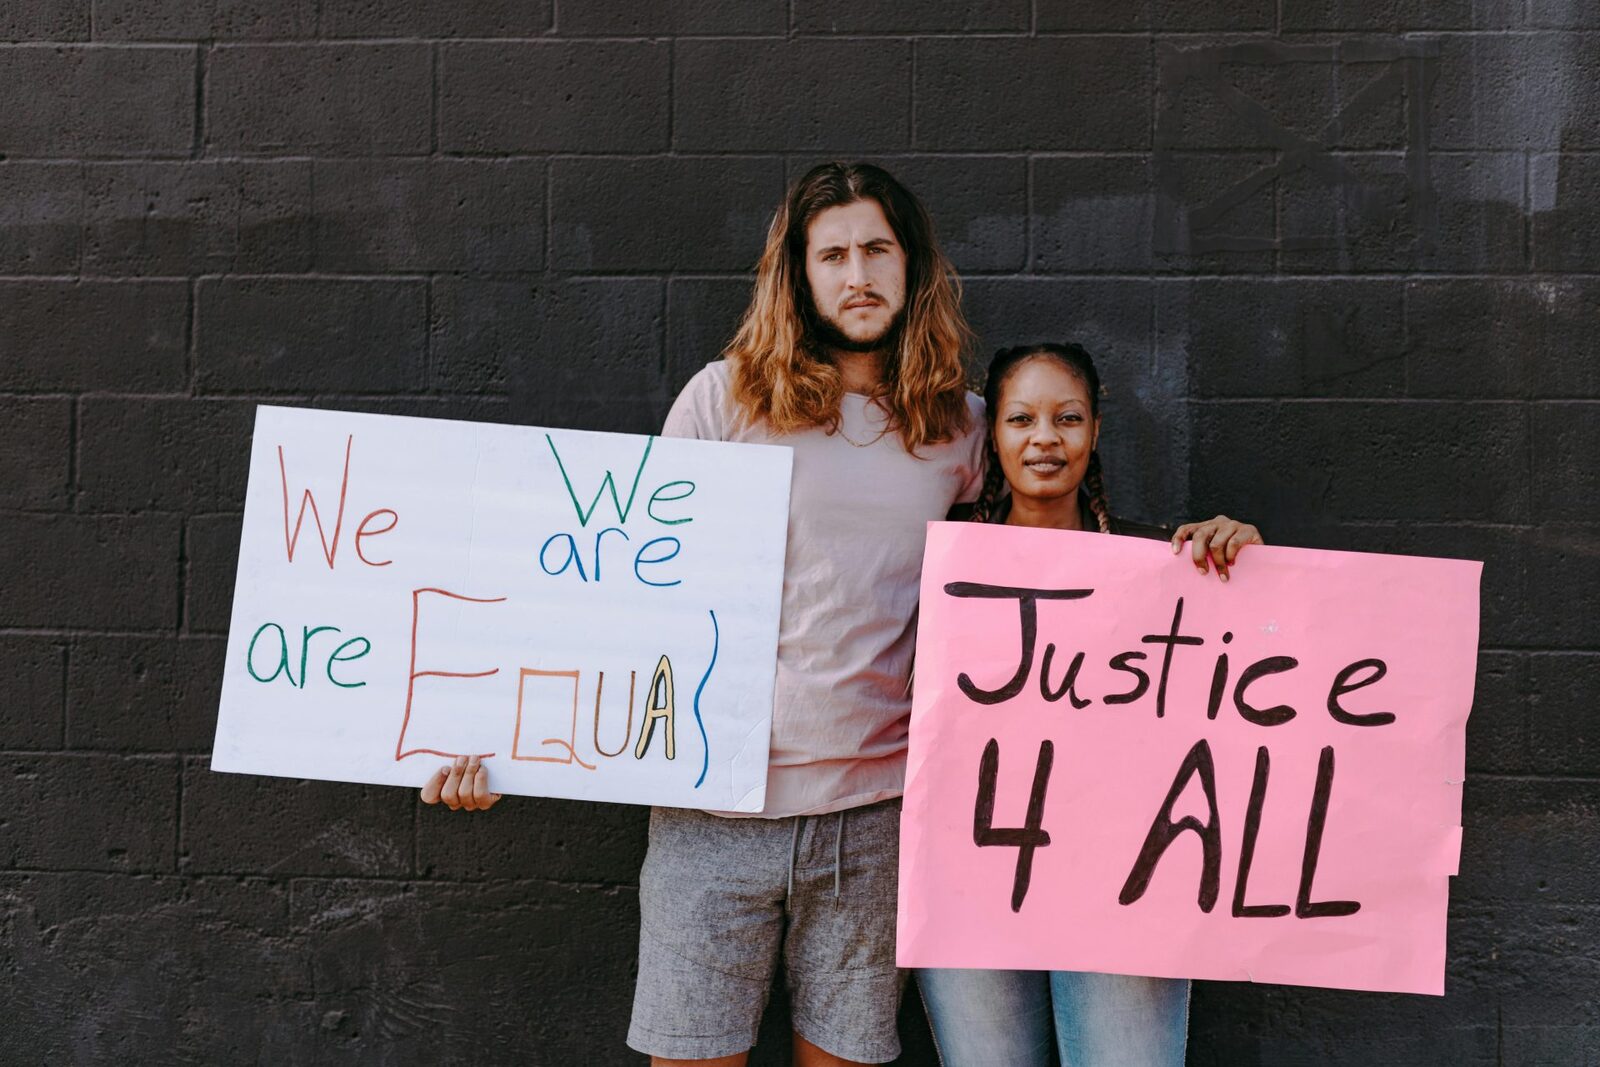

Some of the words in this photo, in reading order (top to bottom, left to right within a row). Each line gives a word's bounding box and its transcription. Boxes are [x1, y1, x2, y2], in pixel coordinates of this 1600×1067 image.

[278, 434, 398, 570] We
[545, 434, 696, 527] We
[538, 527, 682, 587] are
[246, 621, 372, 689] are
[943, 581, 1396, 727] Justice
[972, 737, 1053, 914] 4
[1118, 738, 1362, 919] ALL
